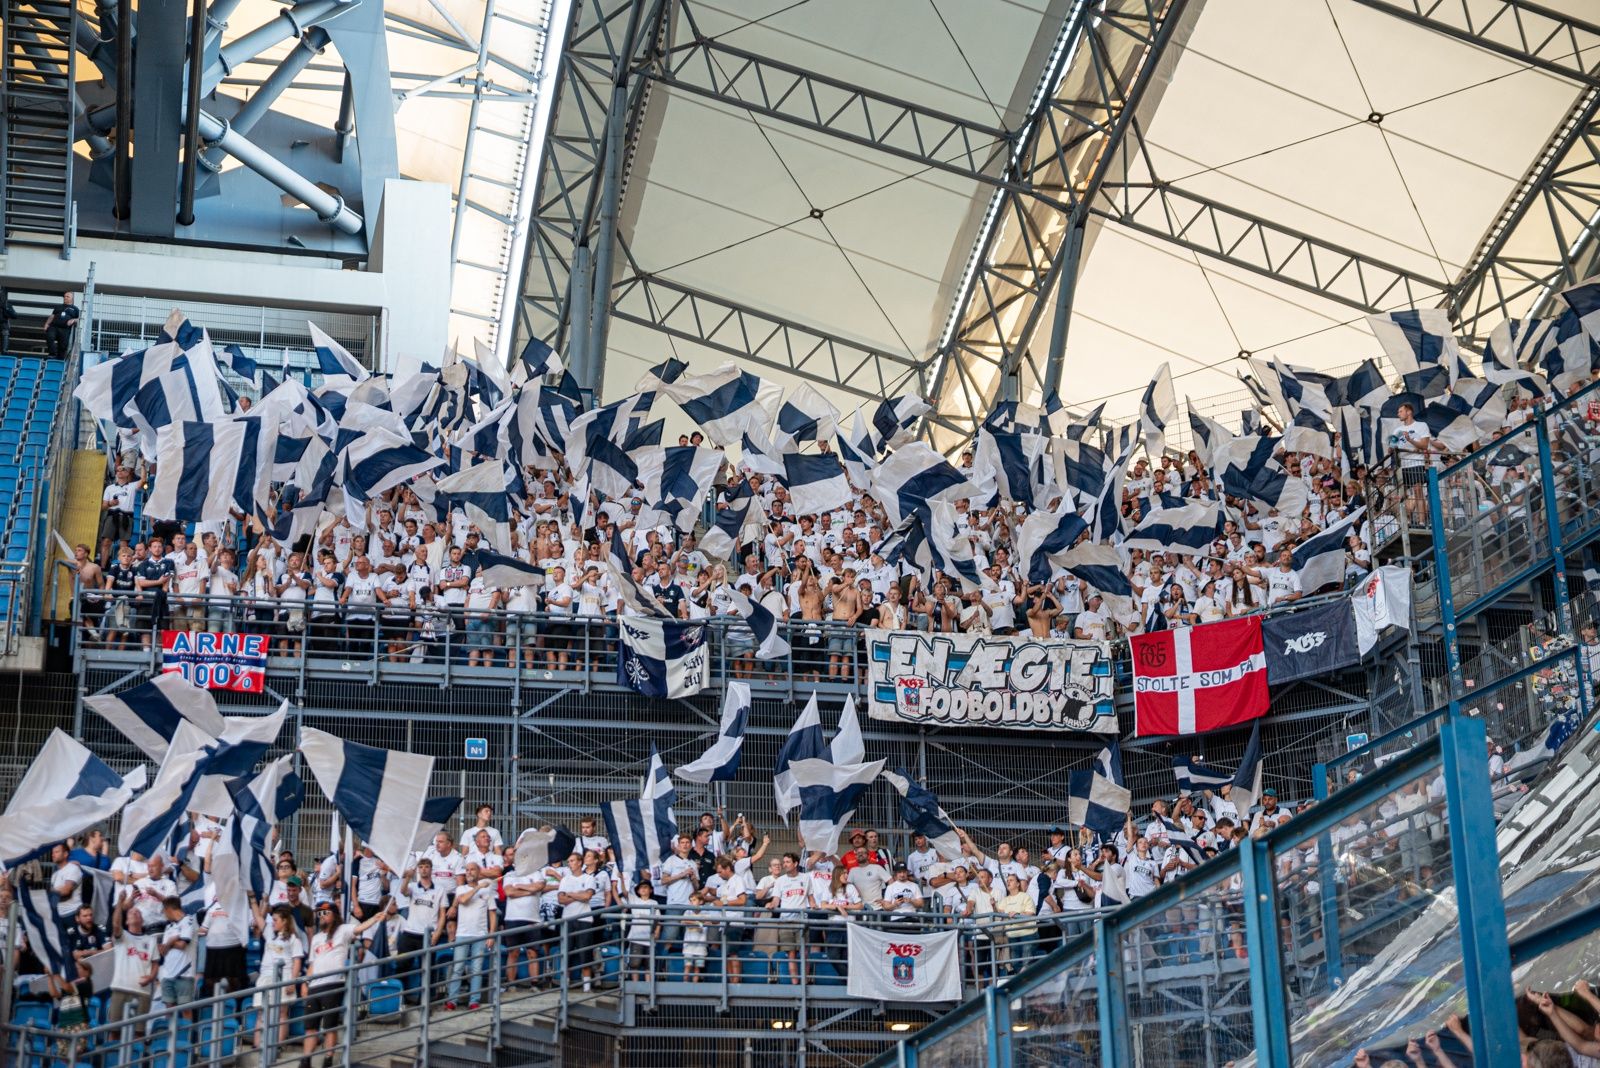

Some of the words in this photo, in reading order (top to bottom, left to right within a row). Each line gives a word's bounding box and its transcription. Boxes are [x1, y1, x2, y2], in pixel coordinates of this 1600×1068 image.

[172, 632, 263, 657] ARNE
[178, 661, 252, 688] 100%
[889, 635, 952, 686] EN
[955, 641, 1099, 694] ÆGTE
[1137, 676, 1190, 691] STOLTE
[1200, 669, 1232, 687] SOM
[918, 687, 1067, 723] FODBOLDBY
[470, 746, 483, 755] N1
